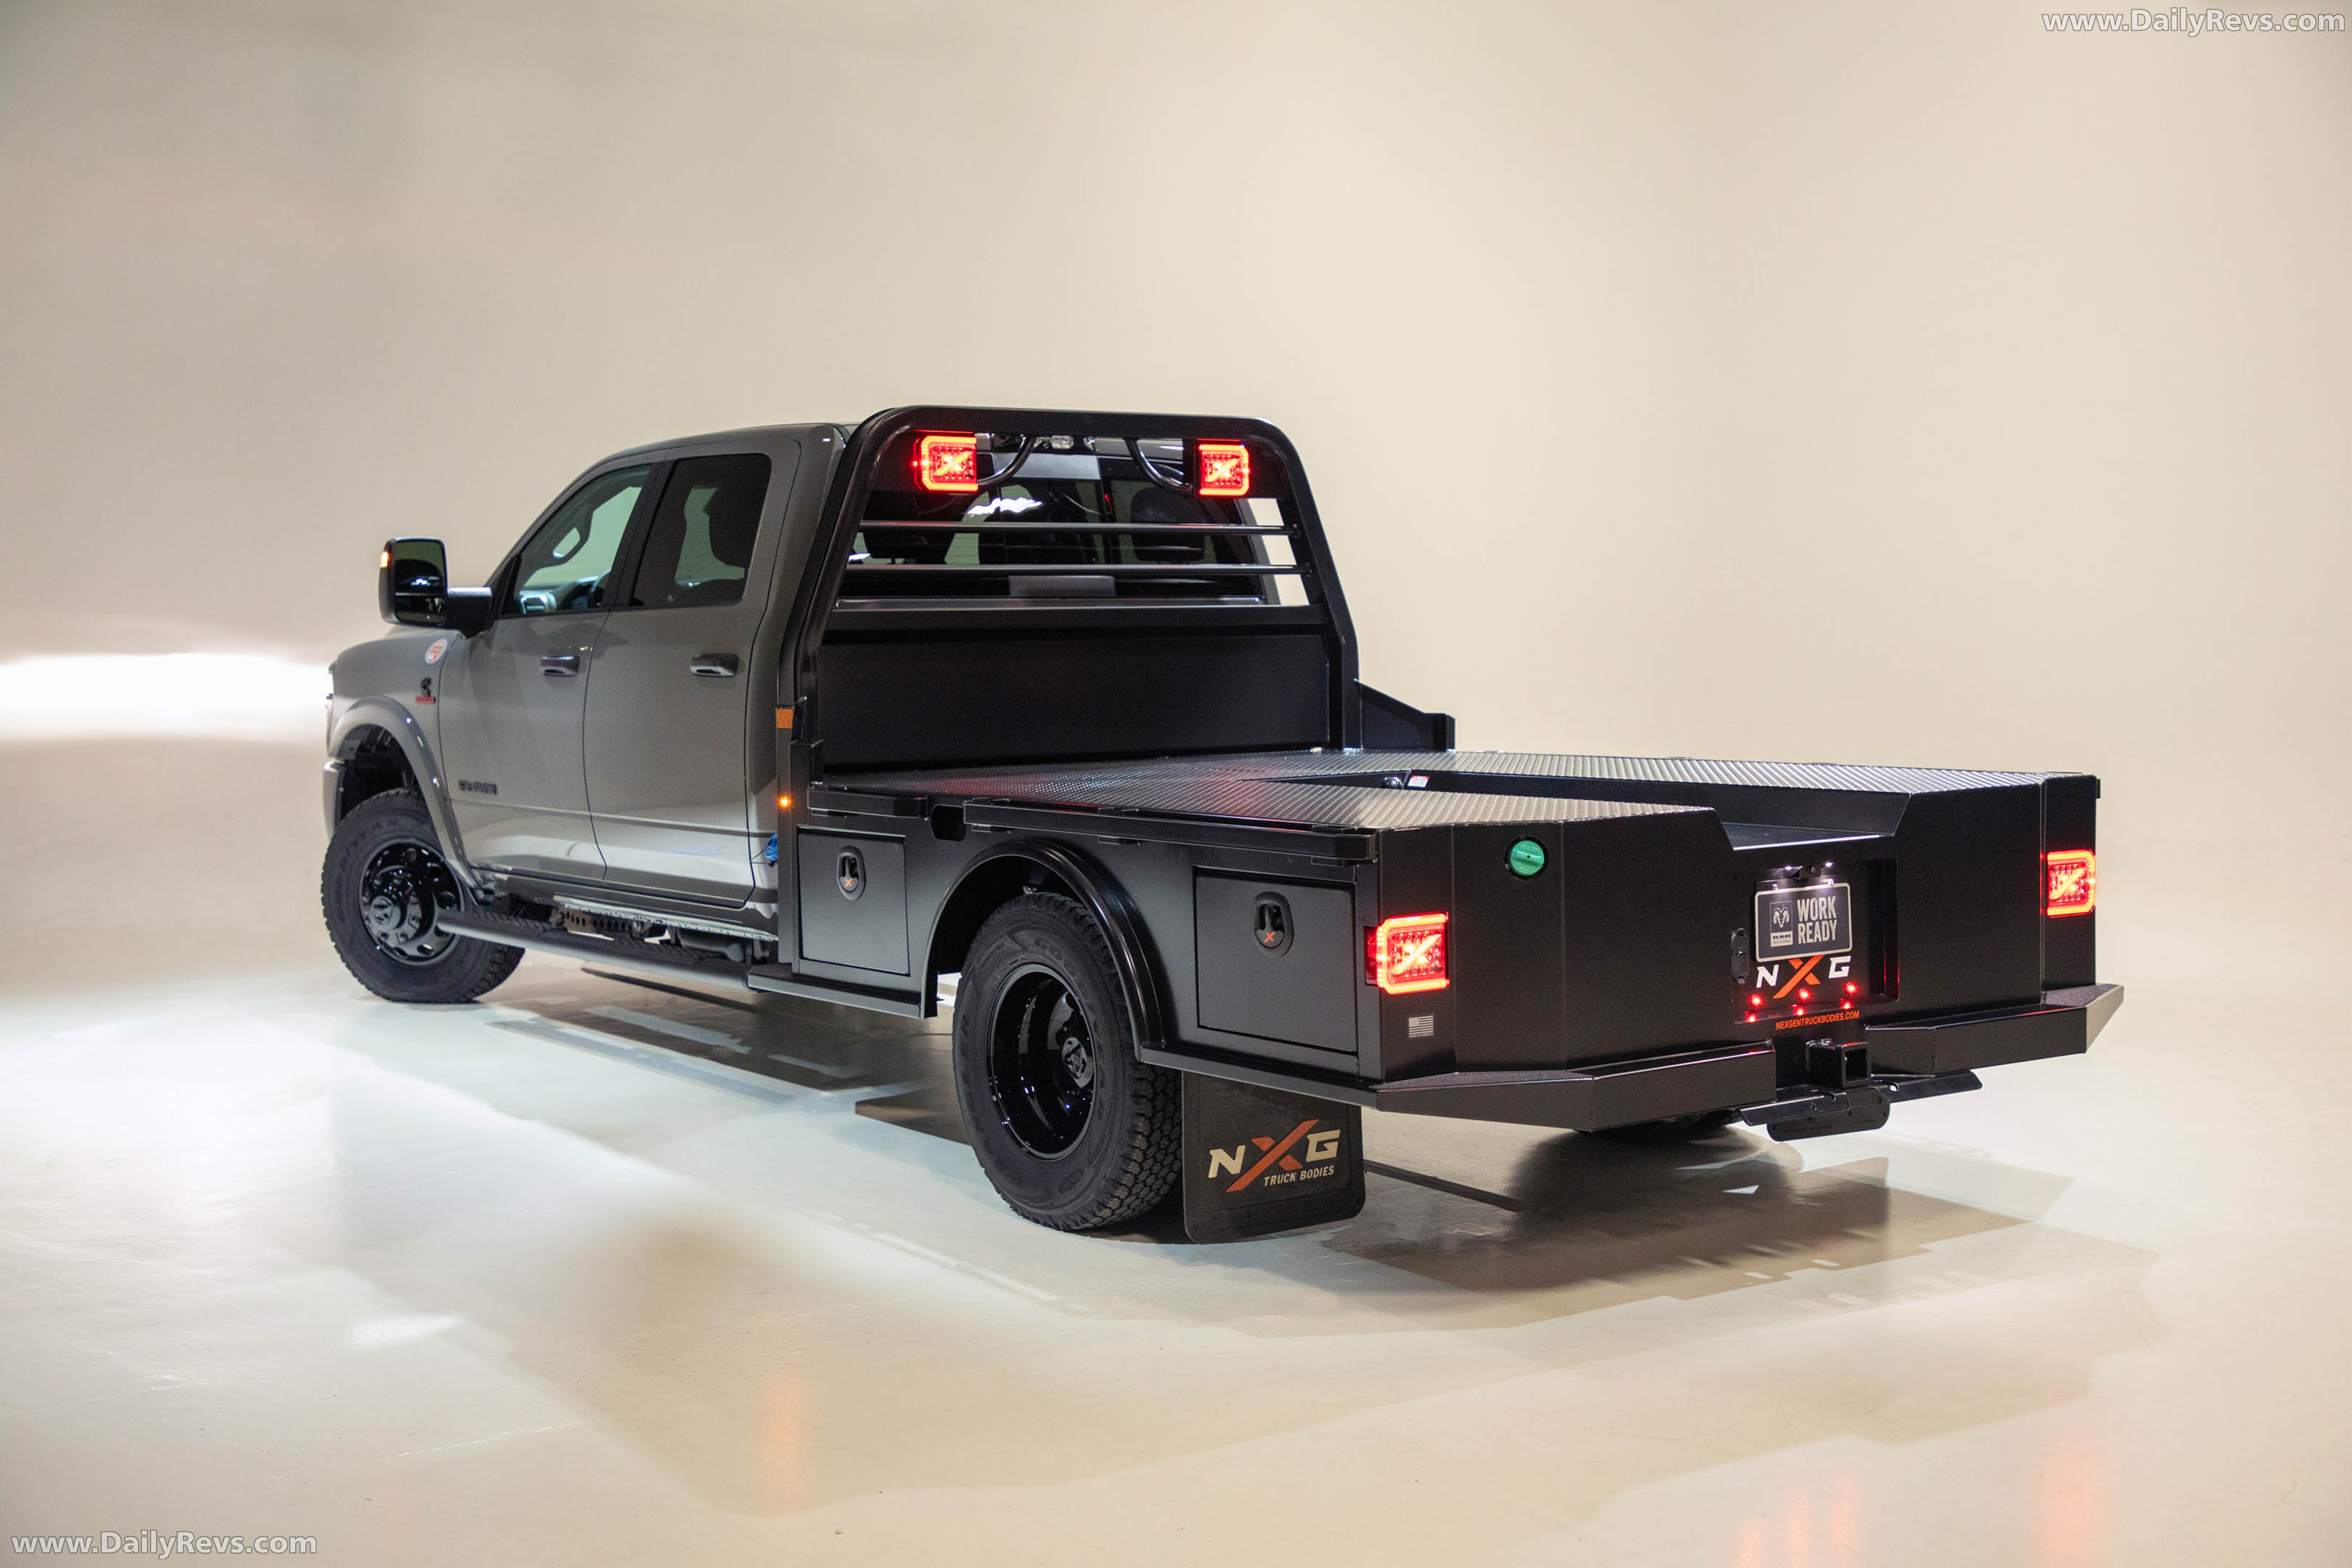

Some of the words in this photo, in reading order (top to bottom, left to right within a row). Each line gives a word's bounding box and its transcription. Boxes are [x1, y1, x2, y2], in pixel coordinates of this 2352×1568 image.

[1797, 897, 1837, 922] WORK
[1797, 920, 1837, 944] READY
[1776, 1010, 1860, 1029] NEXGENTRUCKBODIES.COM
[1264, 1171, 1297, 1186] TRUCK
[1299, 1165, 1335, 1180] BODIES
